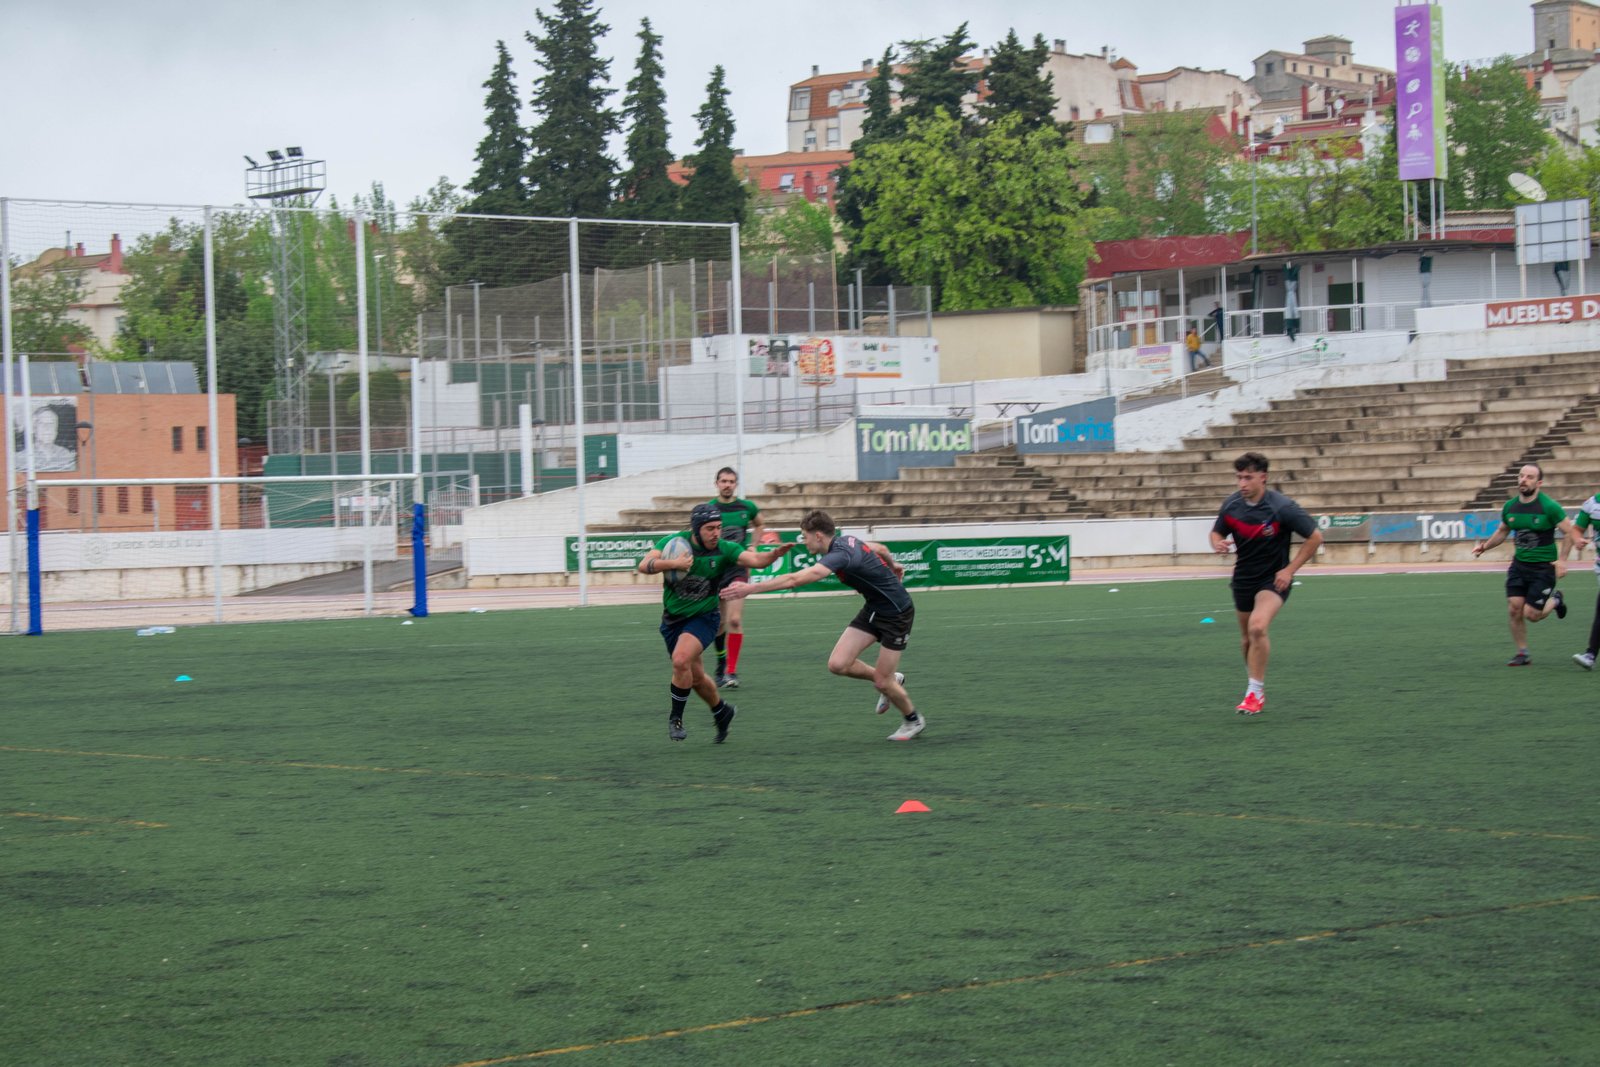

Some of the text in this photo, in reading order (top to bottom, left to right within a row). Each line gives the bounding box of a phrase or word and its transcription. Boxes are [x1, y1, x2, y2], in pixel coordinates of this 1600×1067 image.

[1488, 300, 1600, 325] MUEBLES D
[940, 549, 974, 559] CENTRO
